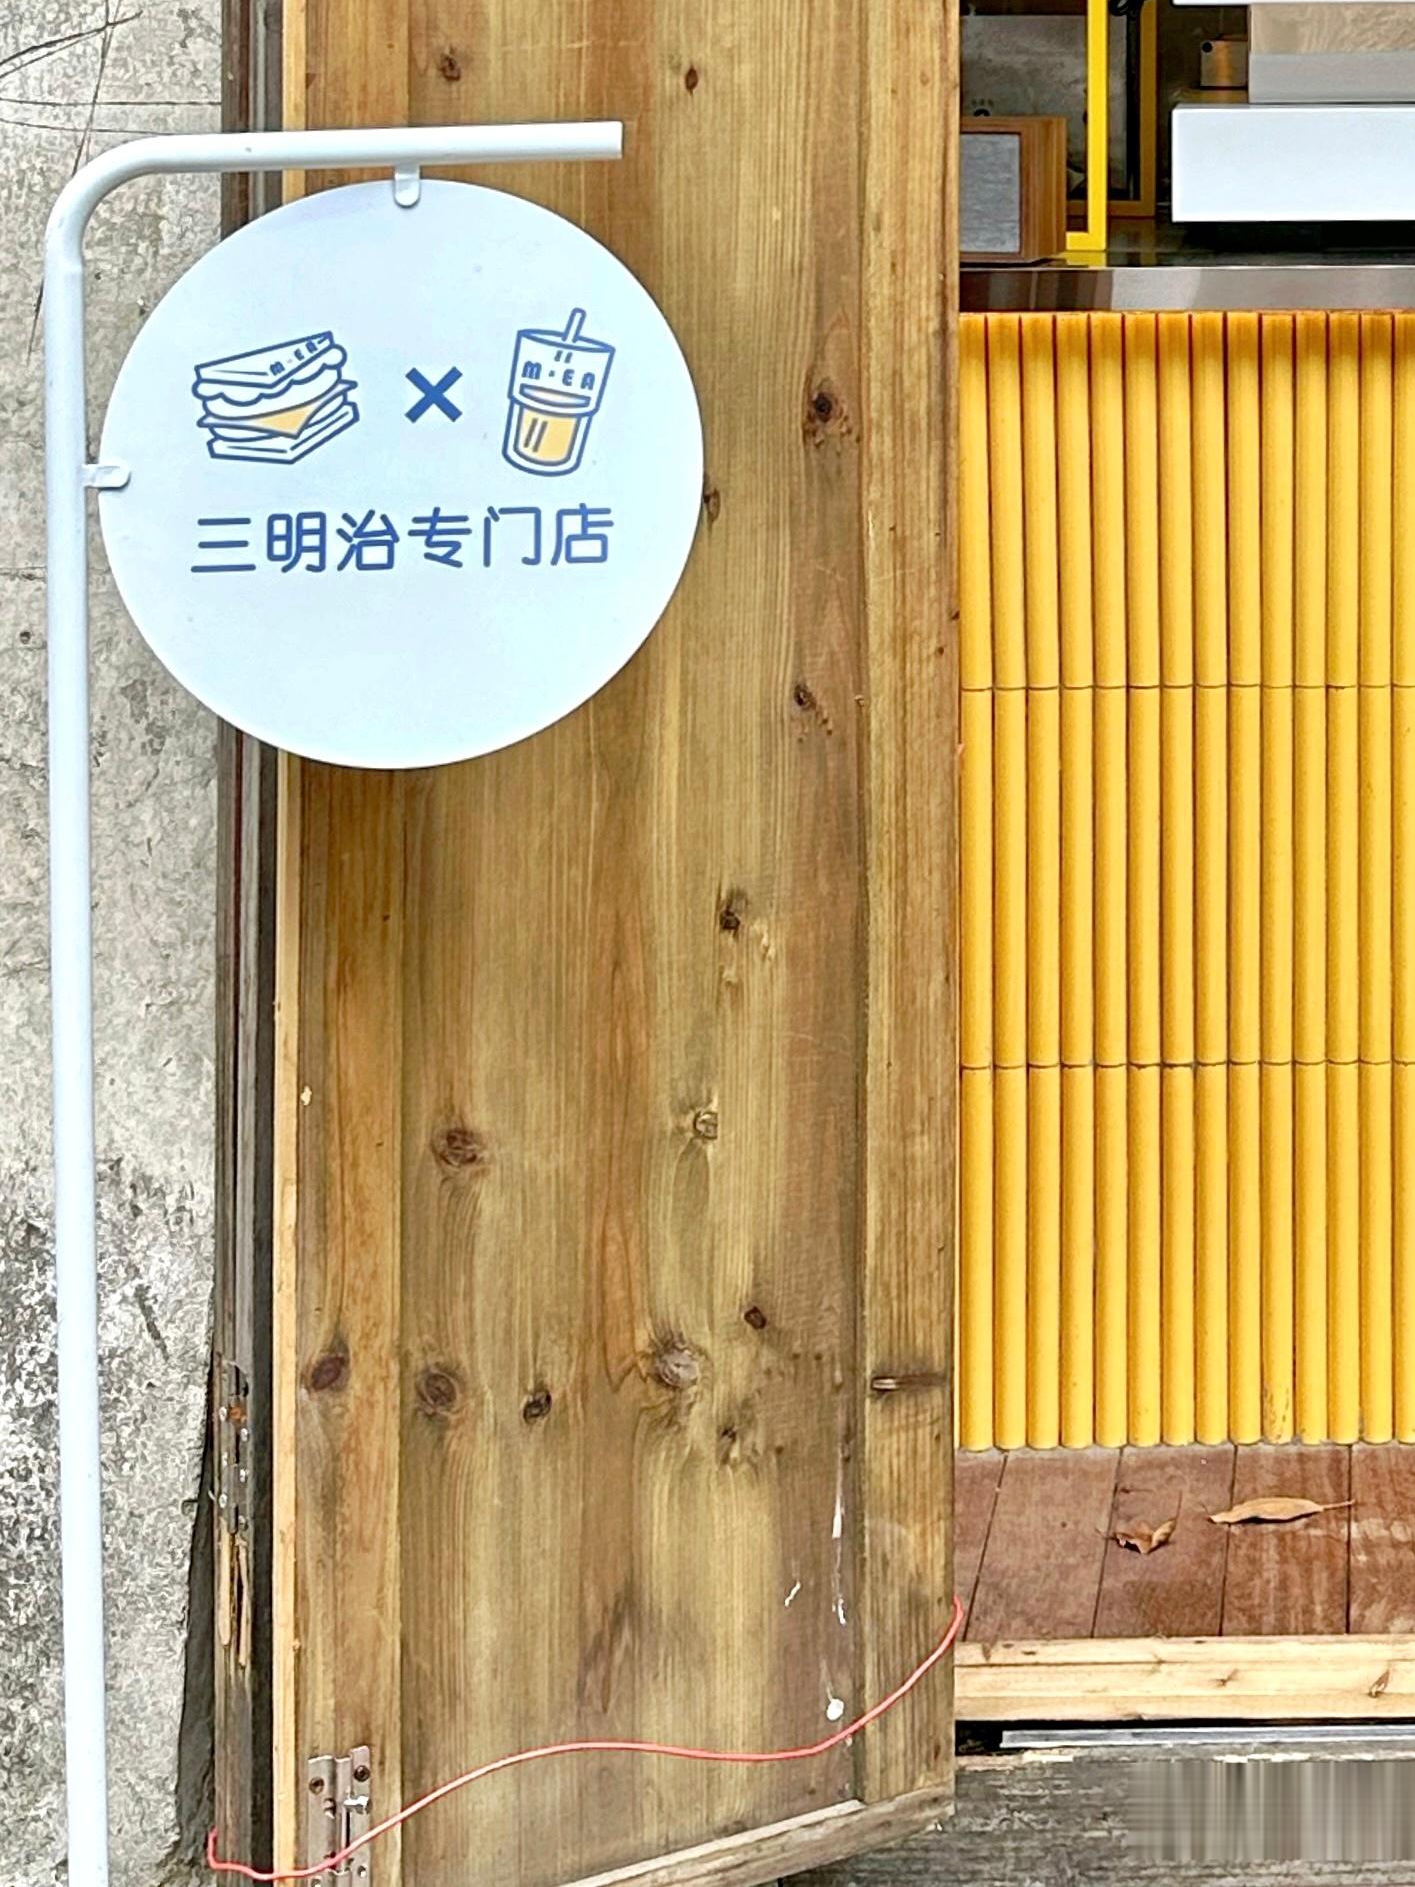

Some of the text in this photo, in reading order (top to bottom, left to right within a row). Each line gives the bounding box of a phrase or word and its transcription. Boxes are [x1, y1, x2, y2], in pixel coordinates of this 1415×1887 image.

[190, 503, 615, 574] 三明治专门店
